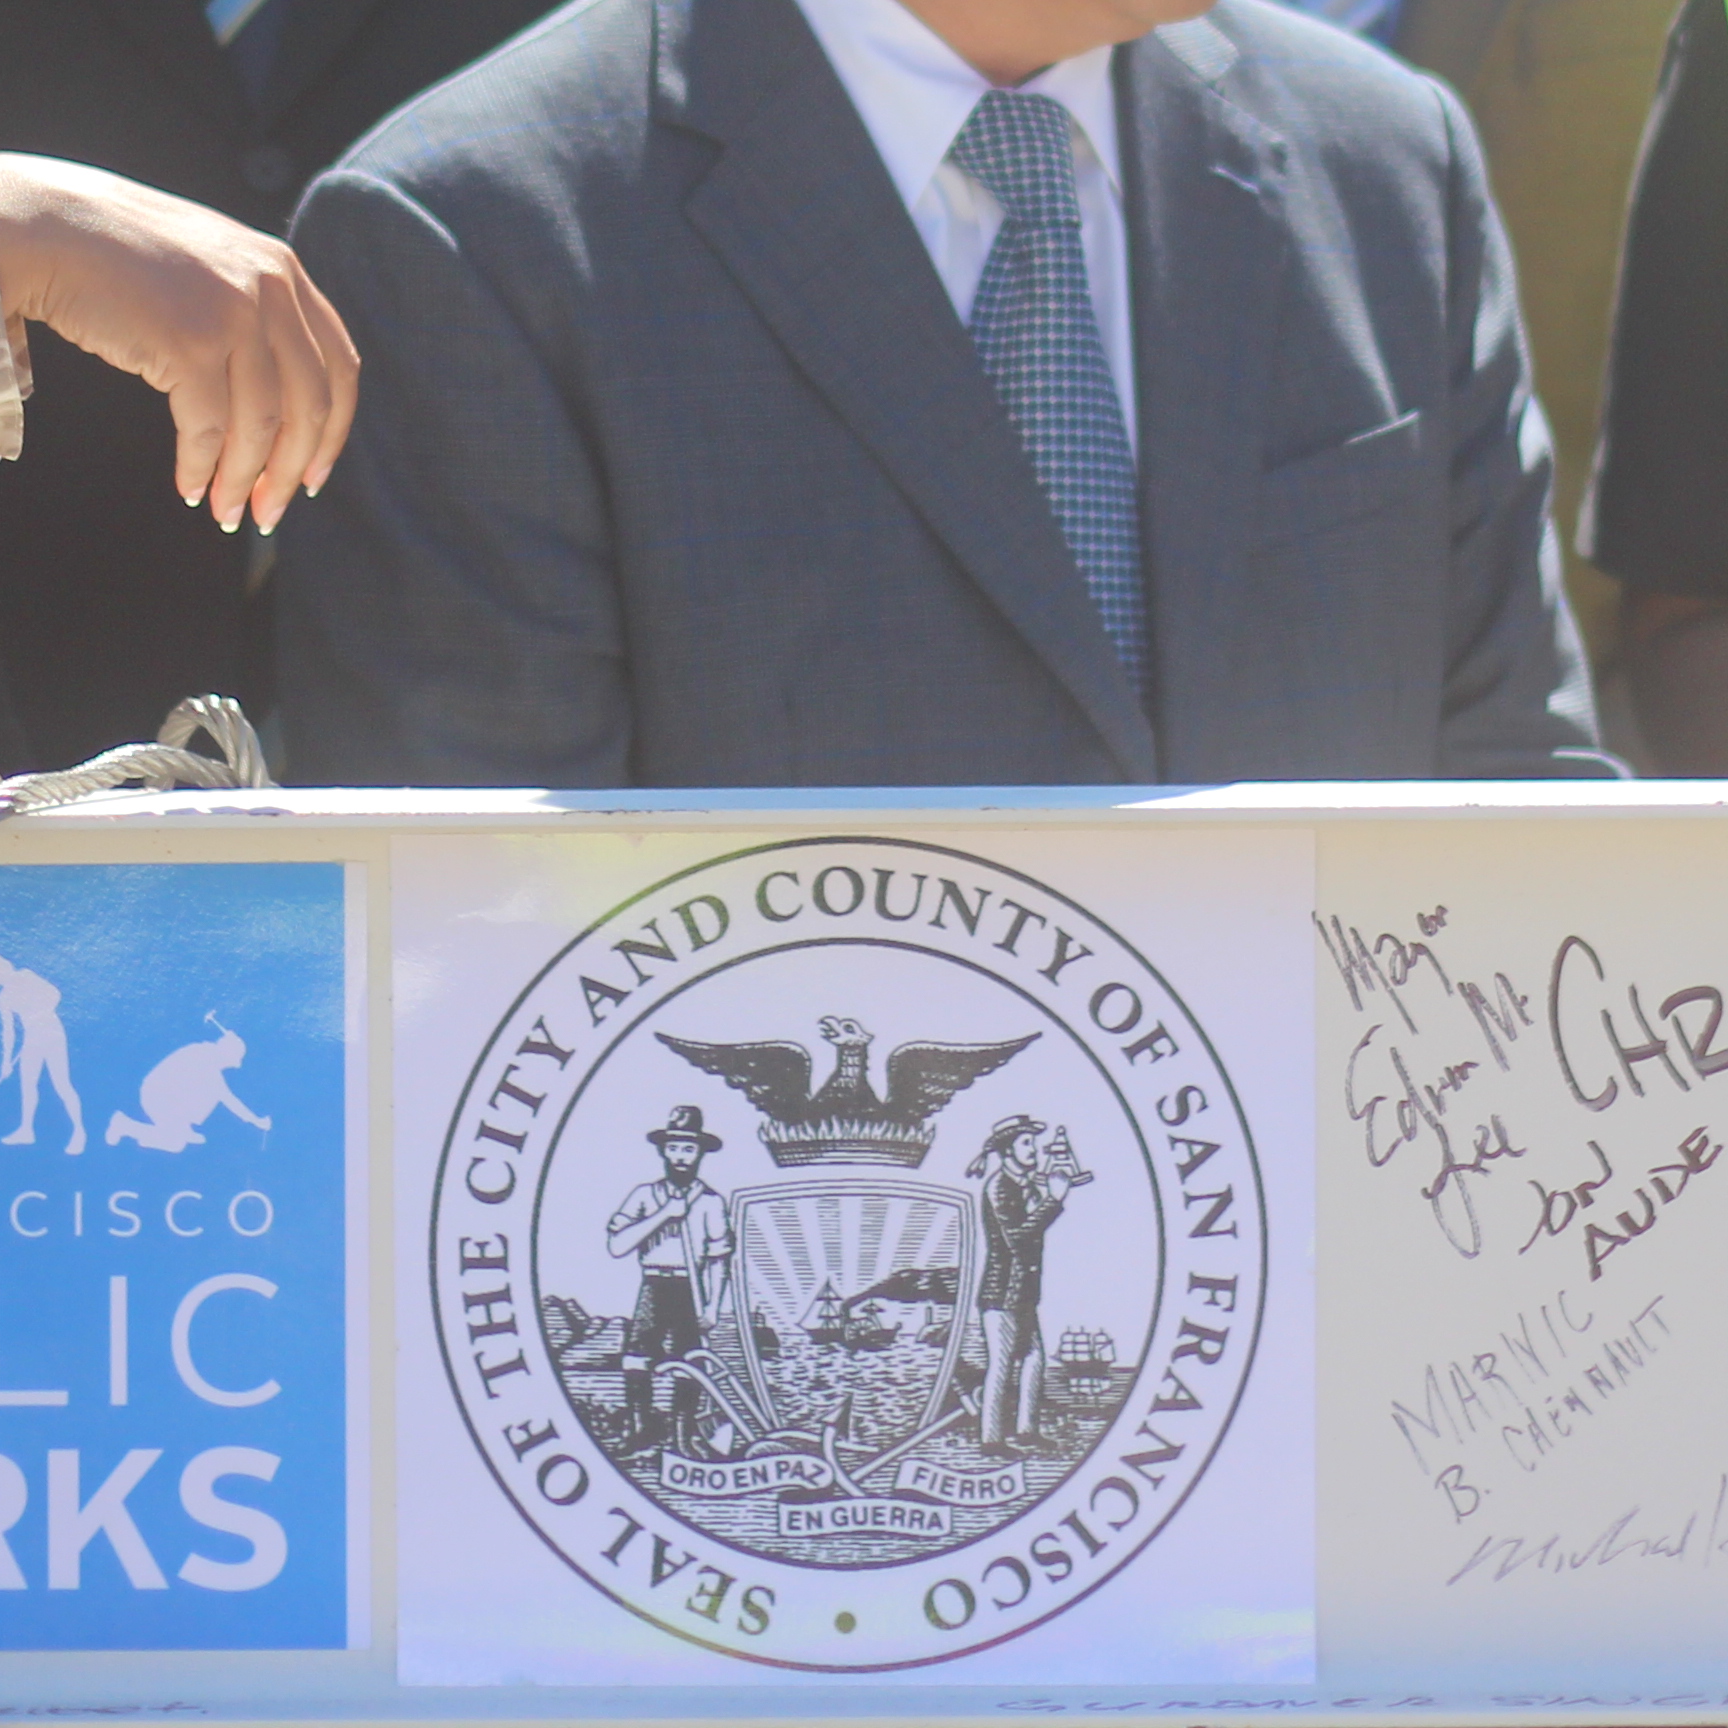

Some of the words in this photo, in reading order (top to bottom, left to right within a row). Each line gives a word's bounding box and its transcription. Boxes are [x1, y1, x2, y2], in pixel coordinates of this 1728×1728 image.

[577, 893, 731, 1029] AND
[754, 864, 1096, 987] COUNTY
[1087, 982, 1180, 1068] OF
[469, 1016, 576, 1207] CITY
[1154, 1084, 1239, 1242] SAN
[459, 1231, 526, 1401] THE
[502, 1419, 591, 1507] OF
[668, 1463, 727, 1491] ORO
[733, 1463, 769, 1490] EN
[775, 1459, 827, 1488] PAZ
[911, 1466, 1017, 1500] FIERRO
[921, 1269, 1238, 1632] FRANCISCO
[599, 1506, 778, 1635] SEAL
[786, 1509, 824, 1532] EN
[829, 1506, 945, 1532] GUERRA
